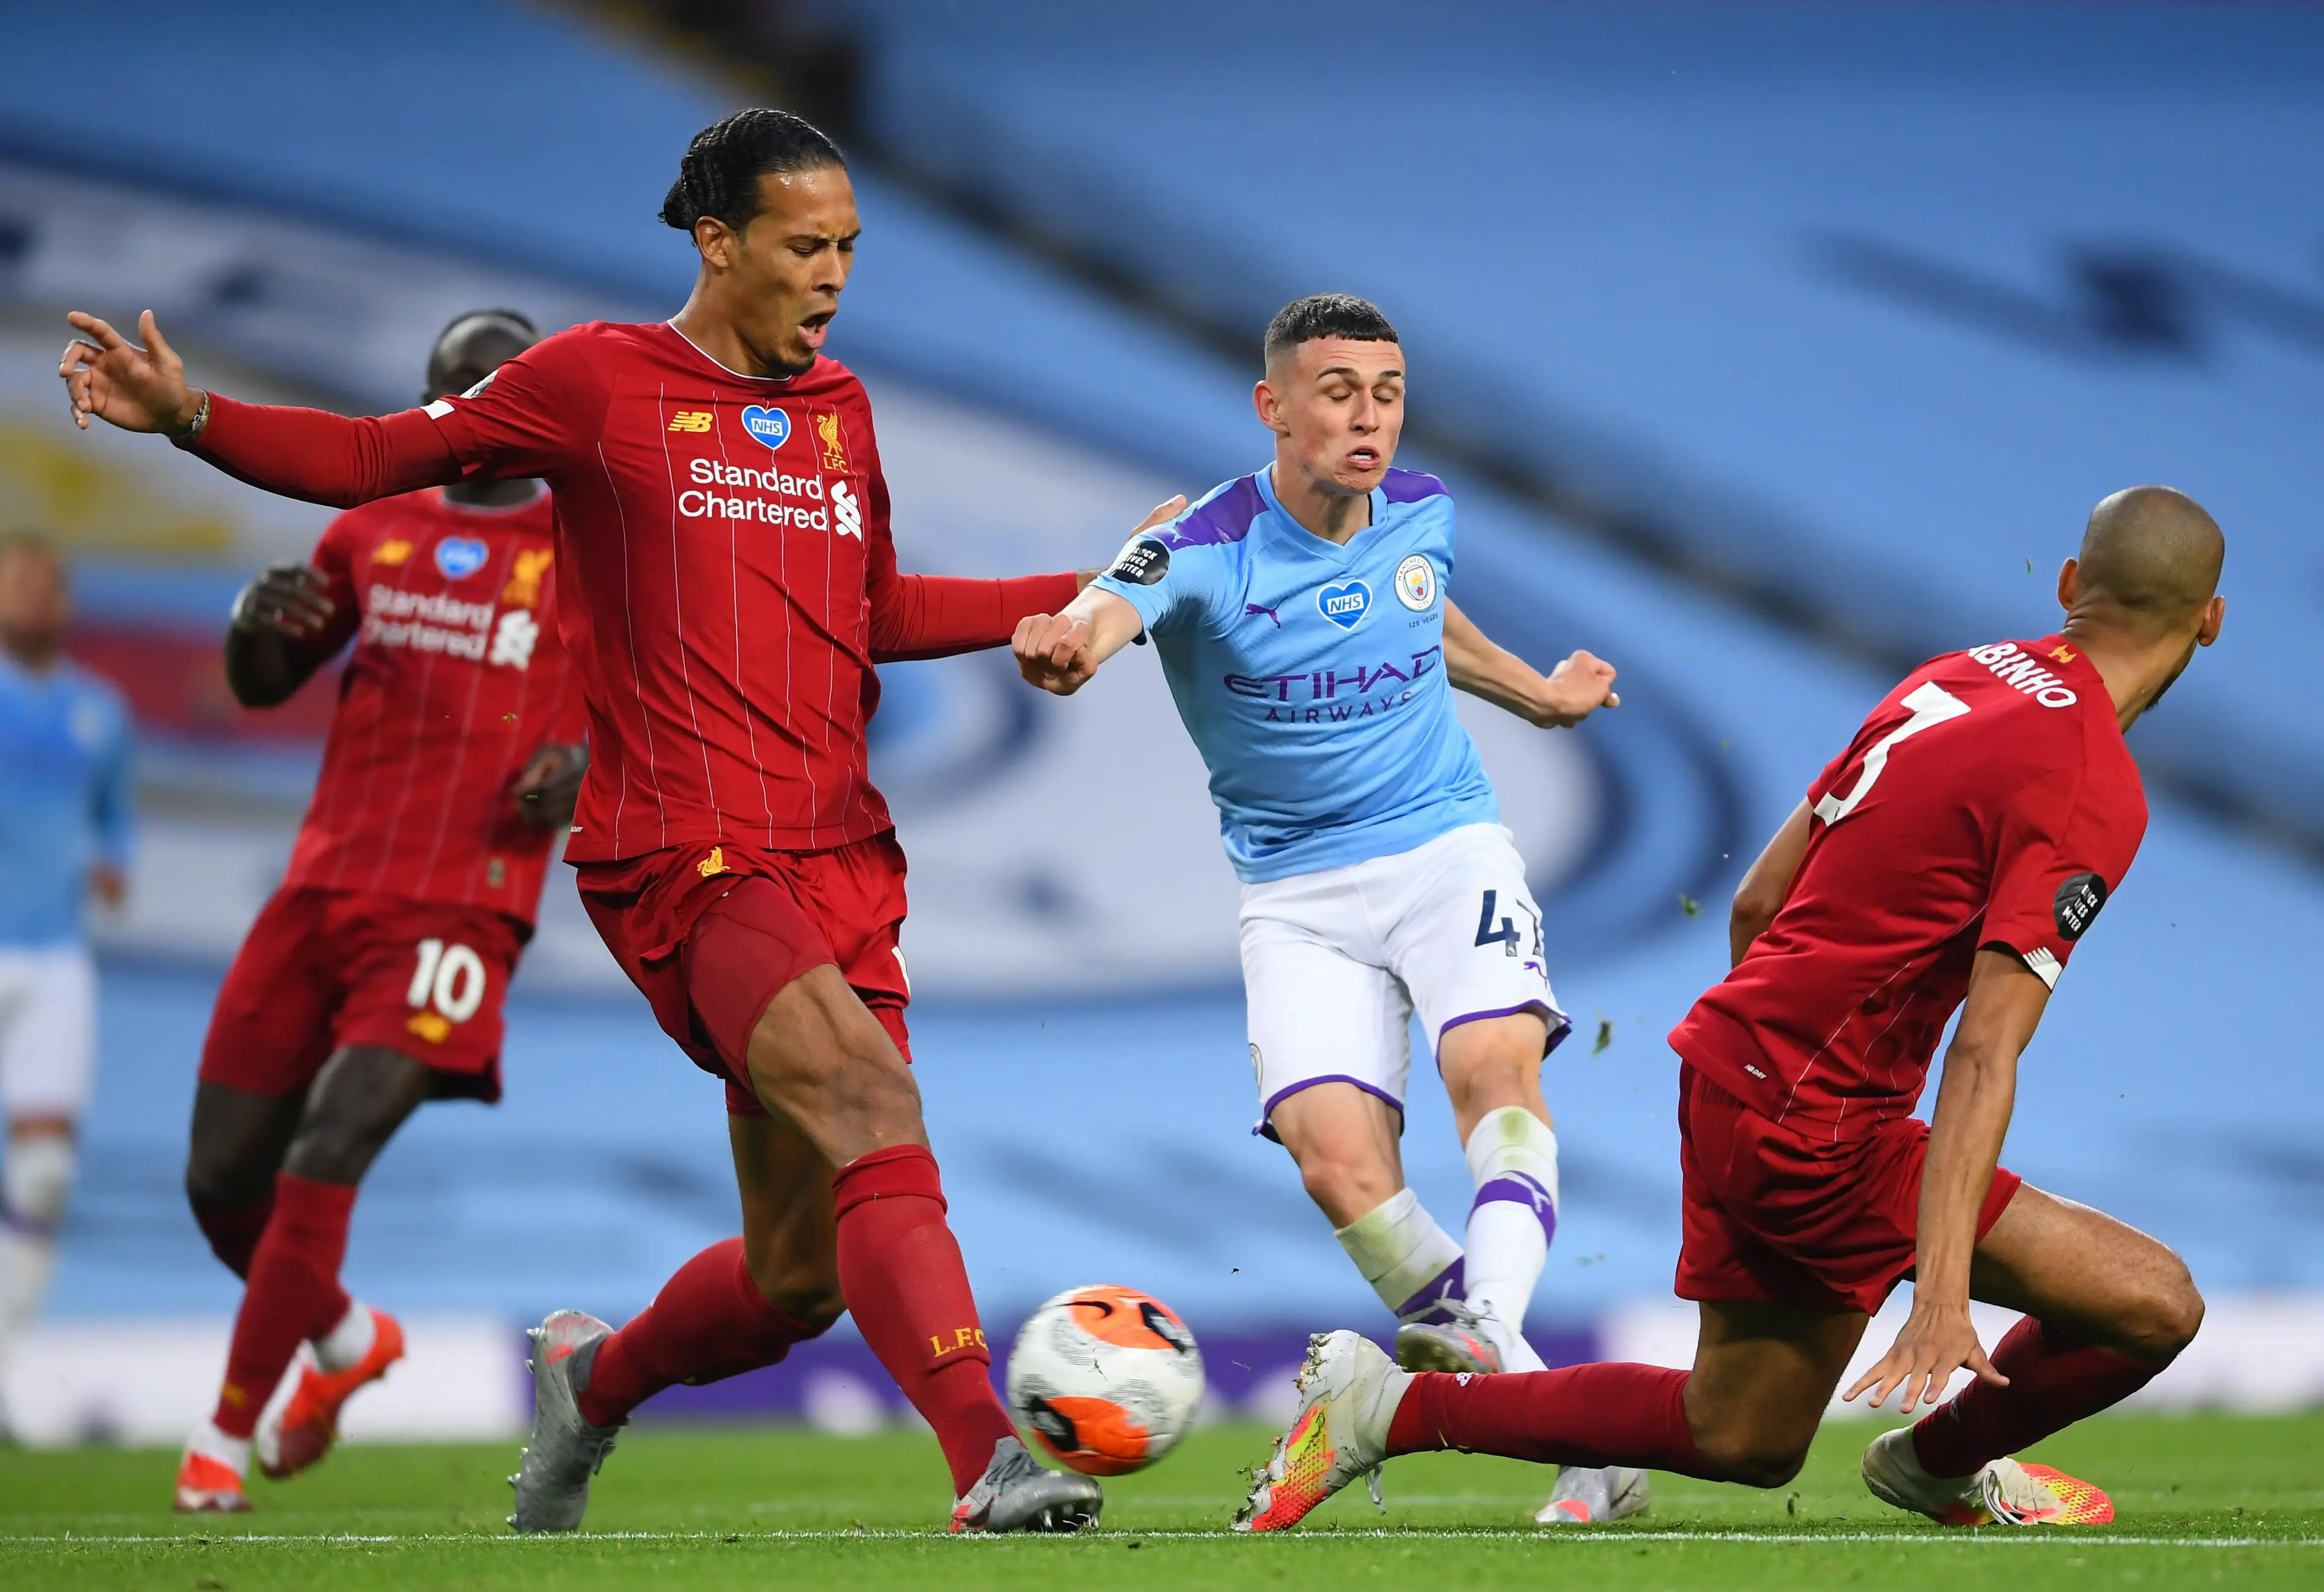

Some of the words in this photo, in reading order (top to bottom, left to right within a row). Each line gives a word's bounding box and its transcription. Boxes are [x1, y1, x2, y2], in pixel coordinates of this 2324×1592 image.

[754, 420, 780, 434] NHS
[690, 458, 823, 500] Standard
[678, 490, 827, 531] Chartered
[1126, 554, 1148, 567] IVES
[1134, 547, 1158, 561] LACK
[1117, 562, 1144, 577] ATTER
[1397, 557, 1430, 582] MANCHESTER
[1330, 596, 1361, 613] NHS
[1417, 600, 1429, 608] CITY
[1422, 613, 1439, 625] YEARS
[1223, 645, 1440, 702] ETIHAD
[1265, 691, 1413, 723] AIRWAYS
[407, 937, 487, 1024] 10
